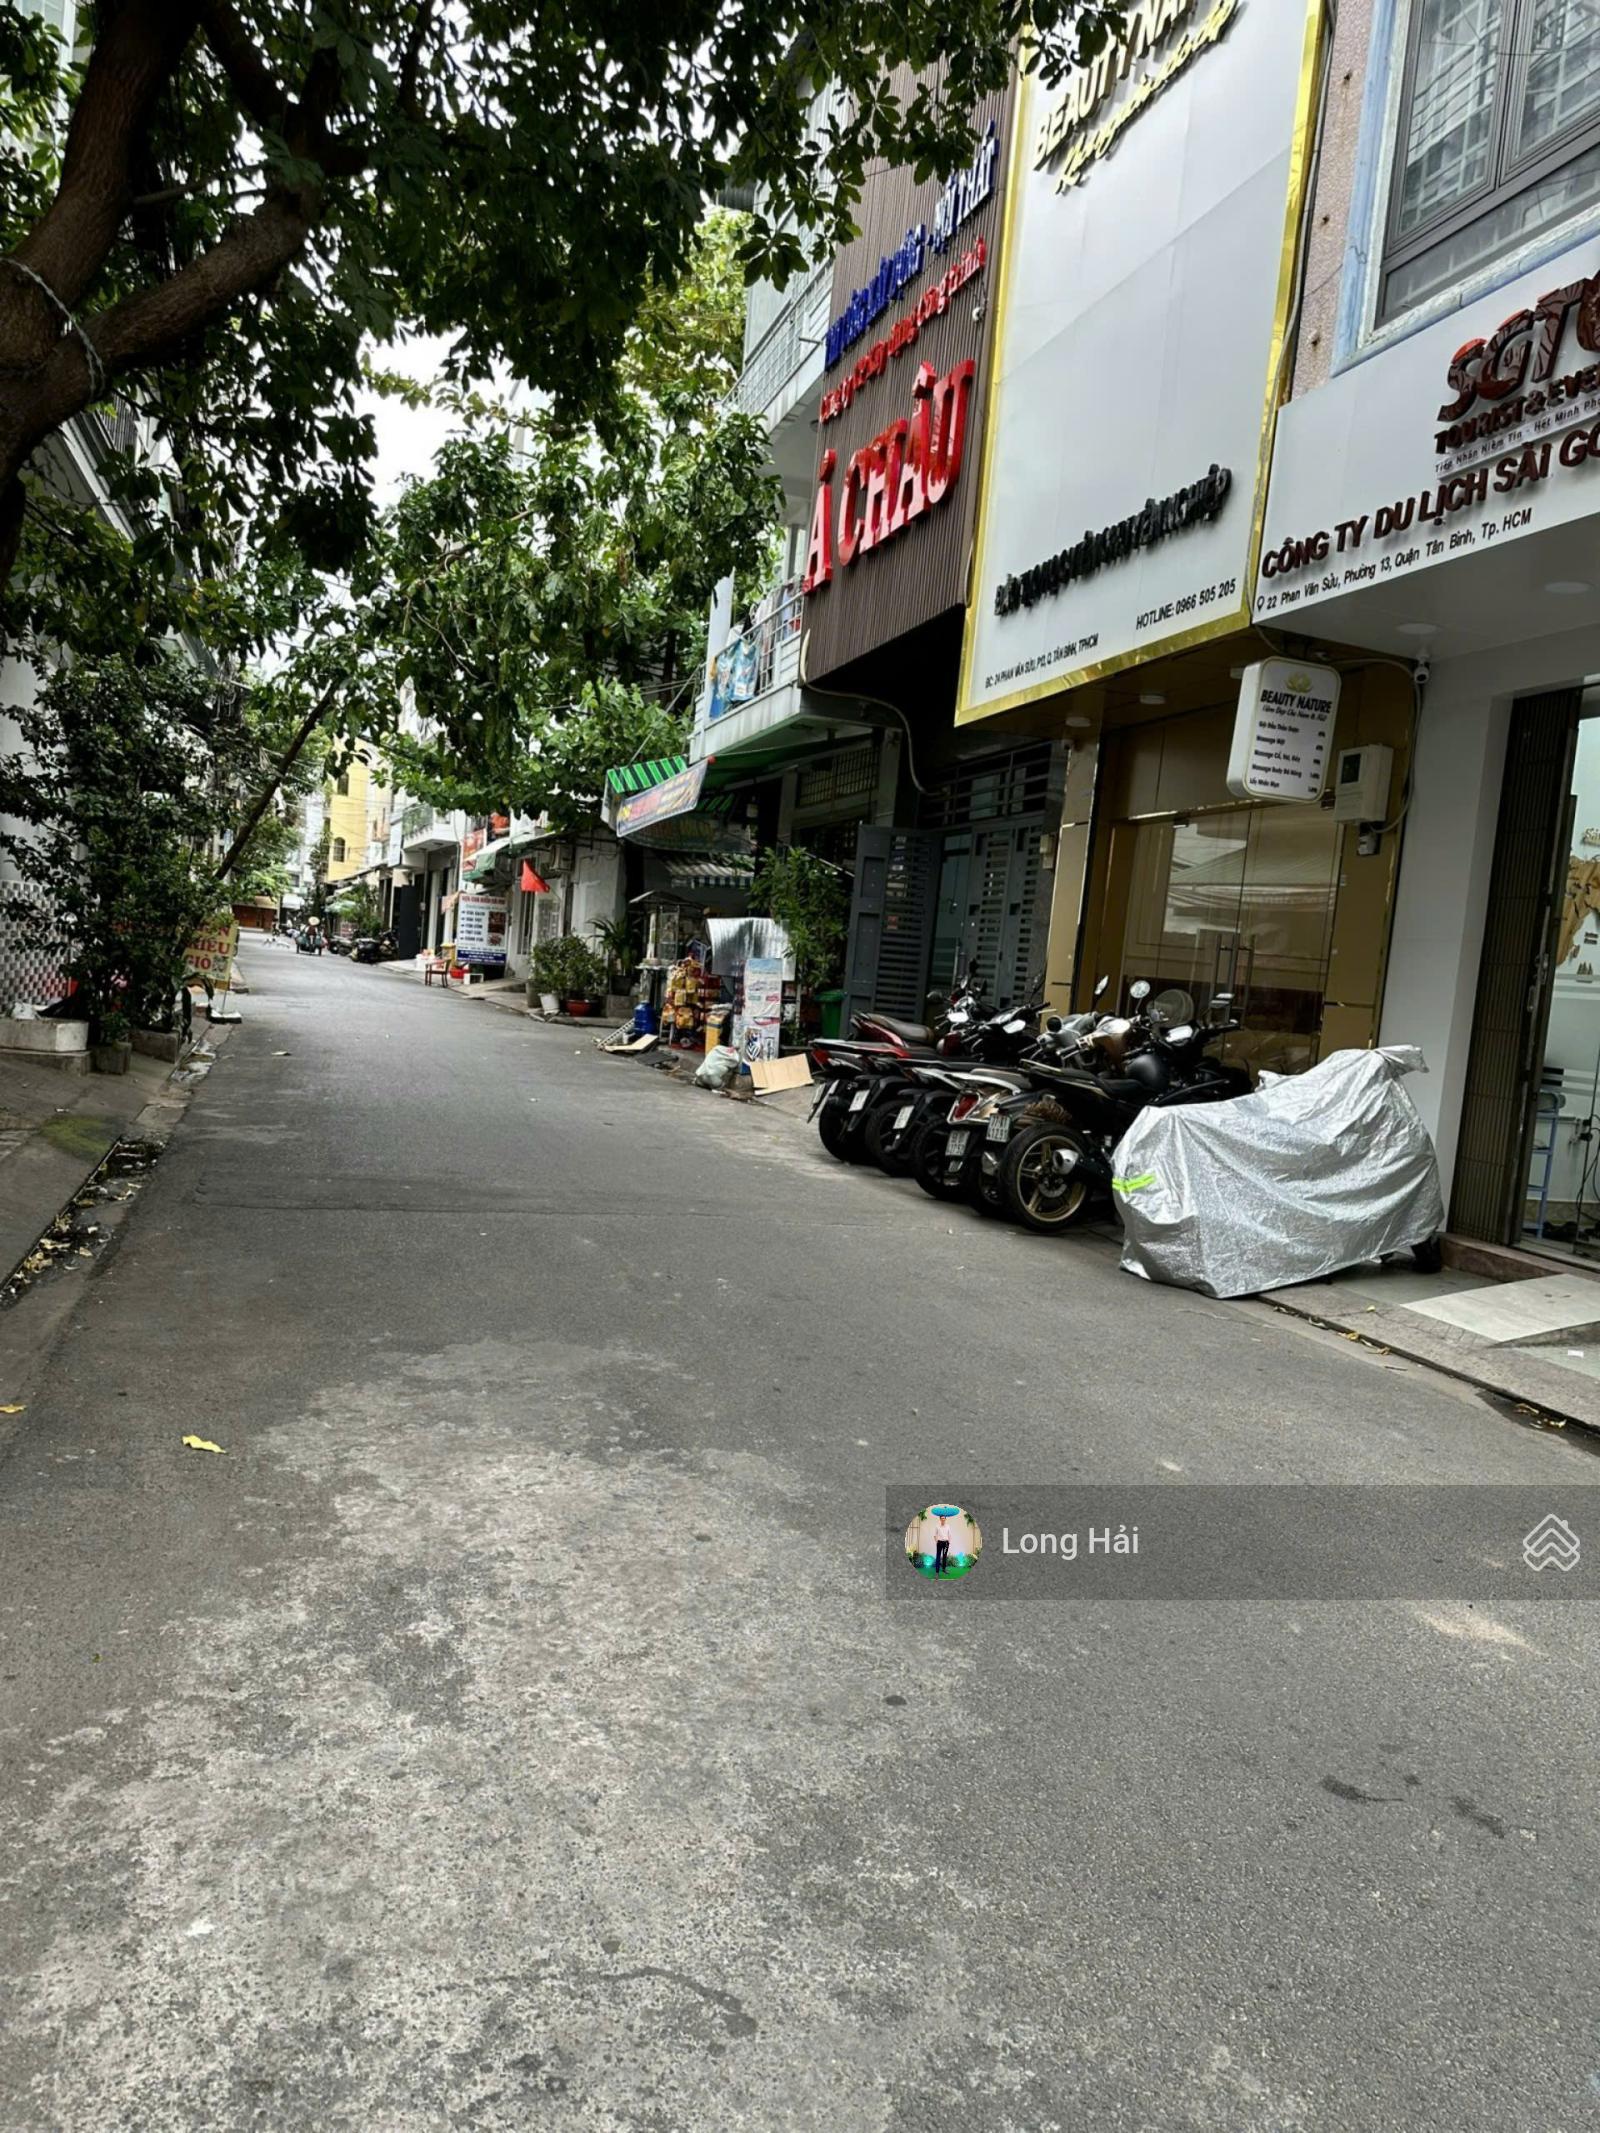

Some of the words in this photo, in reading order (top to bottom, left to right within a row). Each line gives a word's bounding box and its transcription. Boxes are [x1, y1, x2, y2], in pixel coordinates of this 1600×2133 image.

[1434, 396, 1526, 454] TOURIST
[1524, 390, 1546, 416] &
[1547, 361, 1600, 407] EVE
[803, 449, 838, 596] Á
[839, 360, 976, 567] CHÂU
[1262, 537, 1331, 578] CÔNG
[1334, 515, 1369, 552] TY
[1373, 497, 1416, 539] DU
[1418, 467, 1489, 526] LỊCH
[1493, 441, 1553, 493] SÀI
[1135, 602, 1175, 630] HOTLINE:
[1175, 594, 1197, 615] 0966
[1199, 585, 1216, 606] 505
[1218, 578, 1237, 599] 205
[1266, 596, 1277, 609] 22
[1280, 589, 1301, 605] Phan
[1380, 556, 1392, 573] 13,
[1394, 547, 1420, 568] Quận
[1426, 537, 1444, 558] Tân
[1481, 521, 1500, 540] Tp.
[1502, 507, 1533, 532] HCM
[1260, 689, 1296, 706] BEAUTY
[1296, 695, 1333, 713] NATURE
